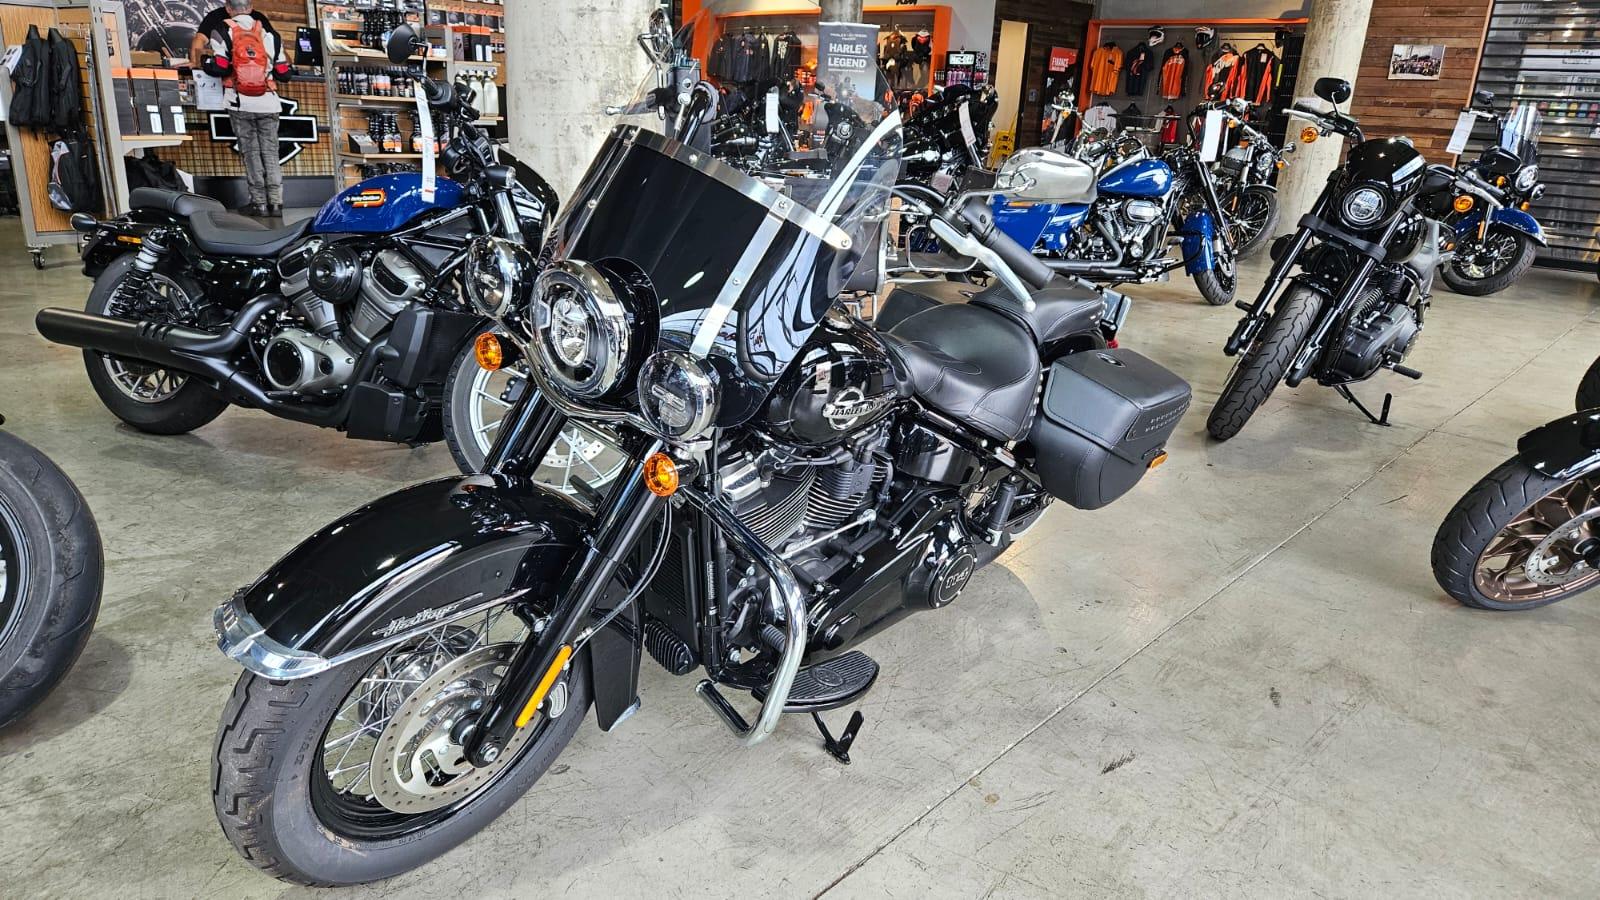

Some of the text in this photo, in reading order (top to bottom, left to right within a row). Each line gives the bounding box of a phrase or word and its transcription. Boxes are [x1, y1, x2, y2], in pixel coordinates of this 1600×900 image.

[829, 43, 867, 54] HARLEY
[828, 57, 867, 68] LEGEND
[946, 567, 968, 589] 114
